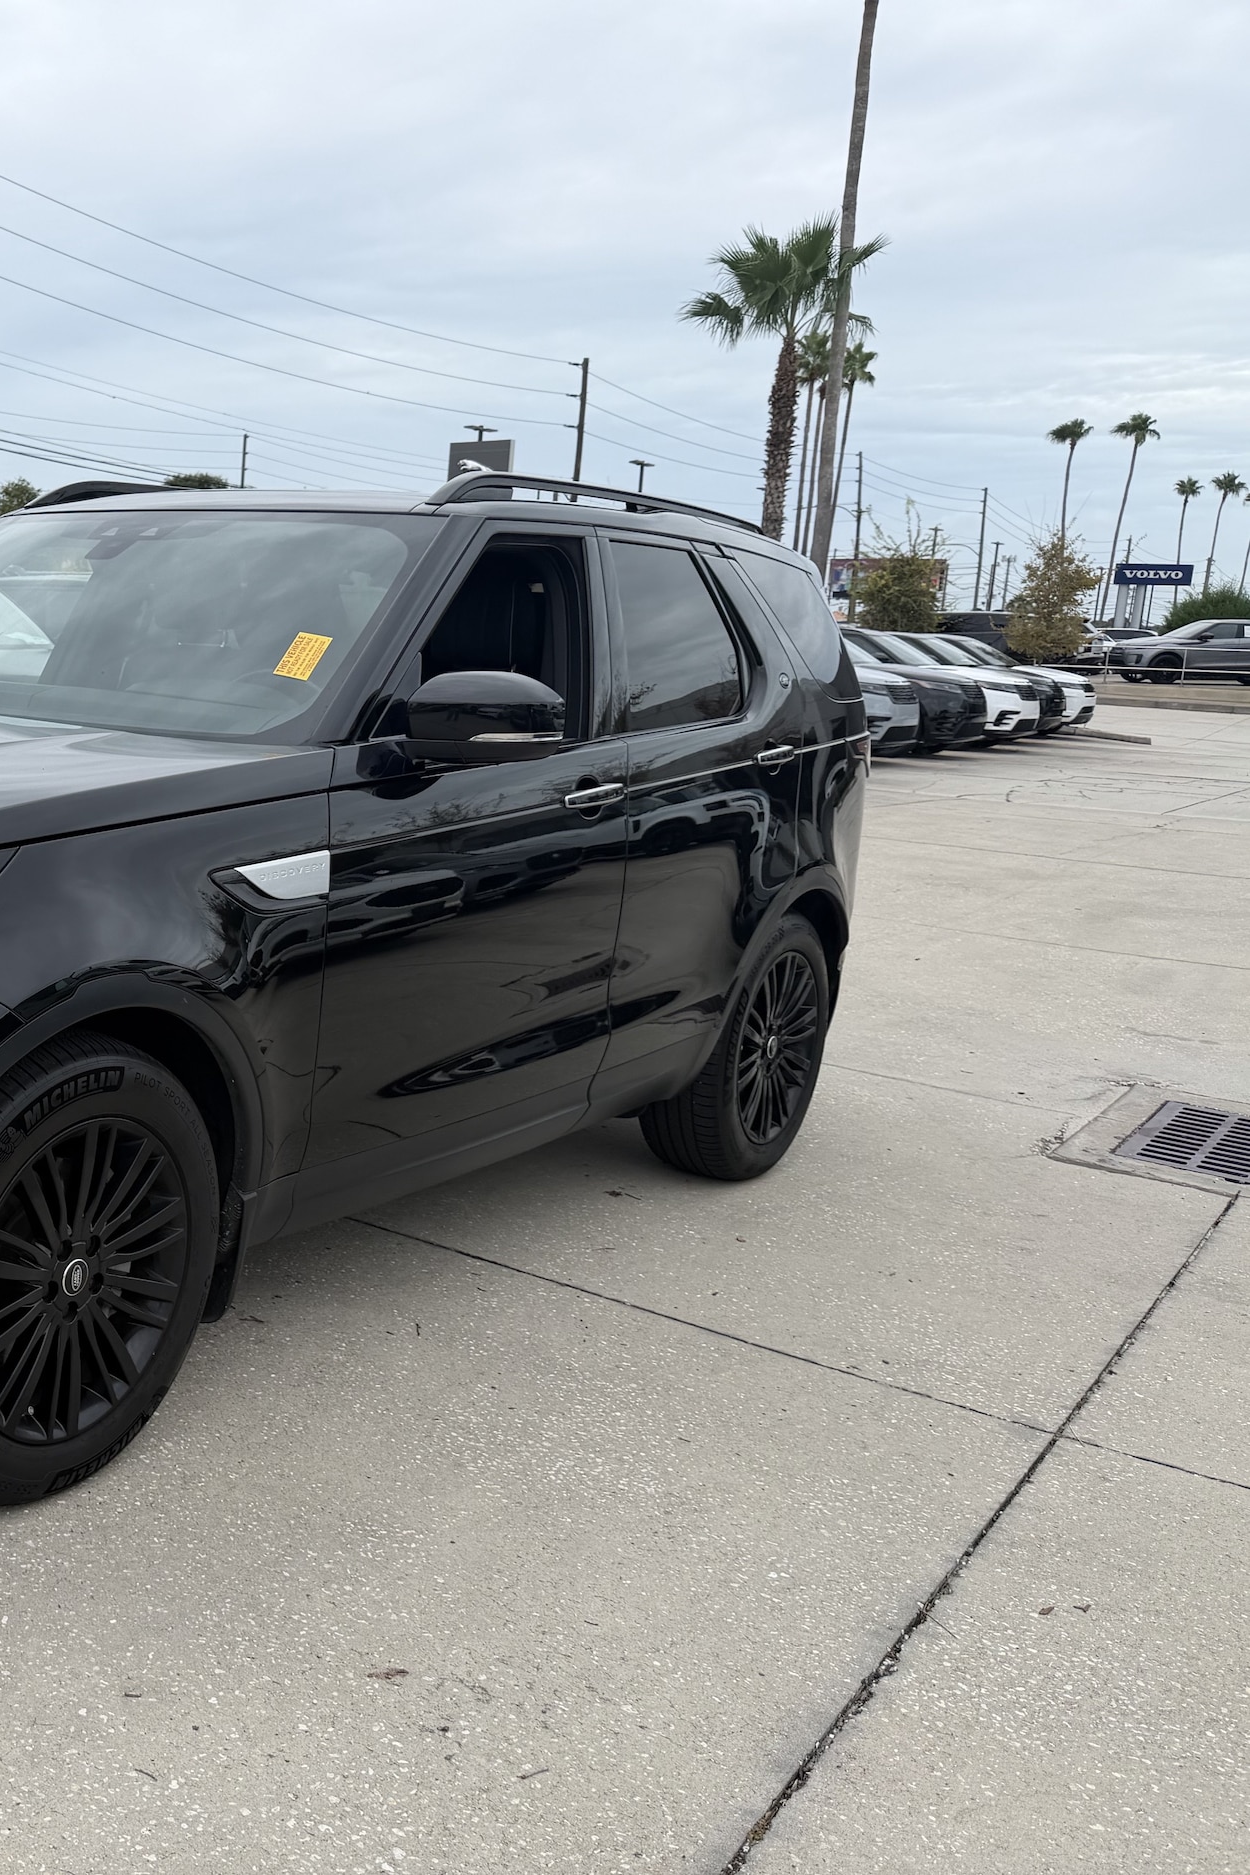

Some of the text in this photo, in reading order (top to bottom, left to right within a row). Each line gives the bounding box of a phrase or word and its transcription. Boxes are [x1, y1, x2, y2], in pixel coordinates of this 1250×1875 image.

[1123, 570, 1183, 579] VOLVO
[276, 635, 306, 673] THIS VEHICLE
[259, 862, 325, 882] DISCOVERY
[24, 1071, 121, 1129] MICHELIN
[134, 1072, 162, 1089] PILOT
[163, 1086, 191, 1115] SPORT
[190, 1119, 203, 1141] ALL
